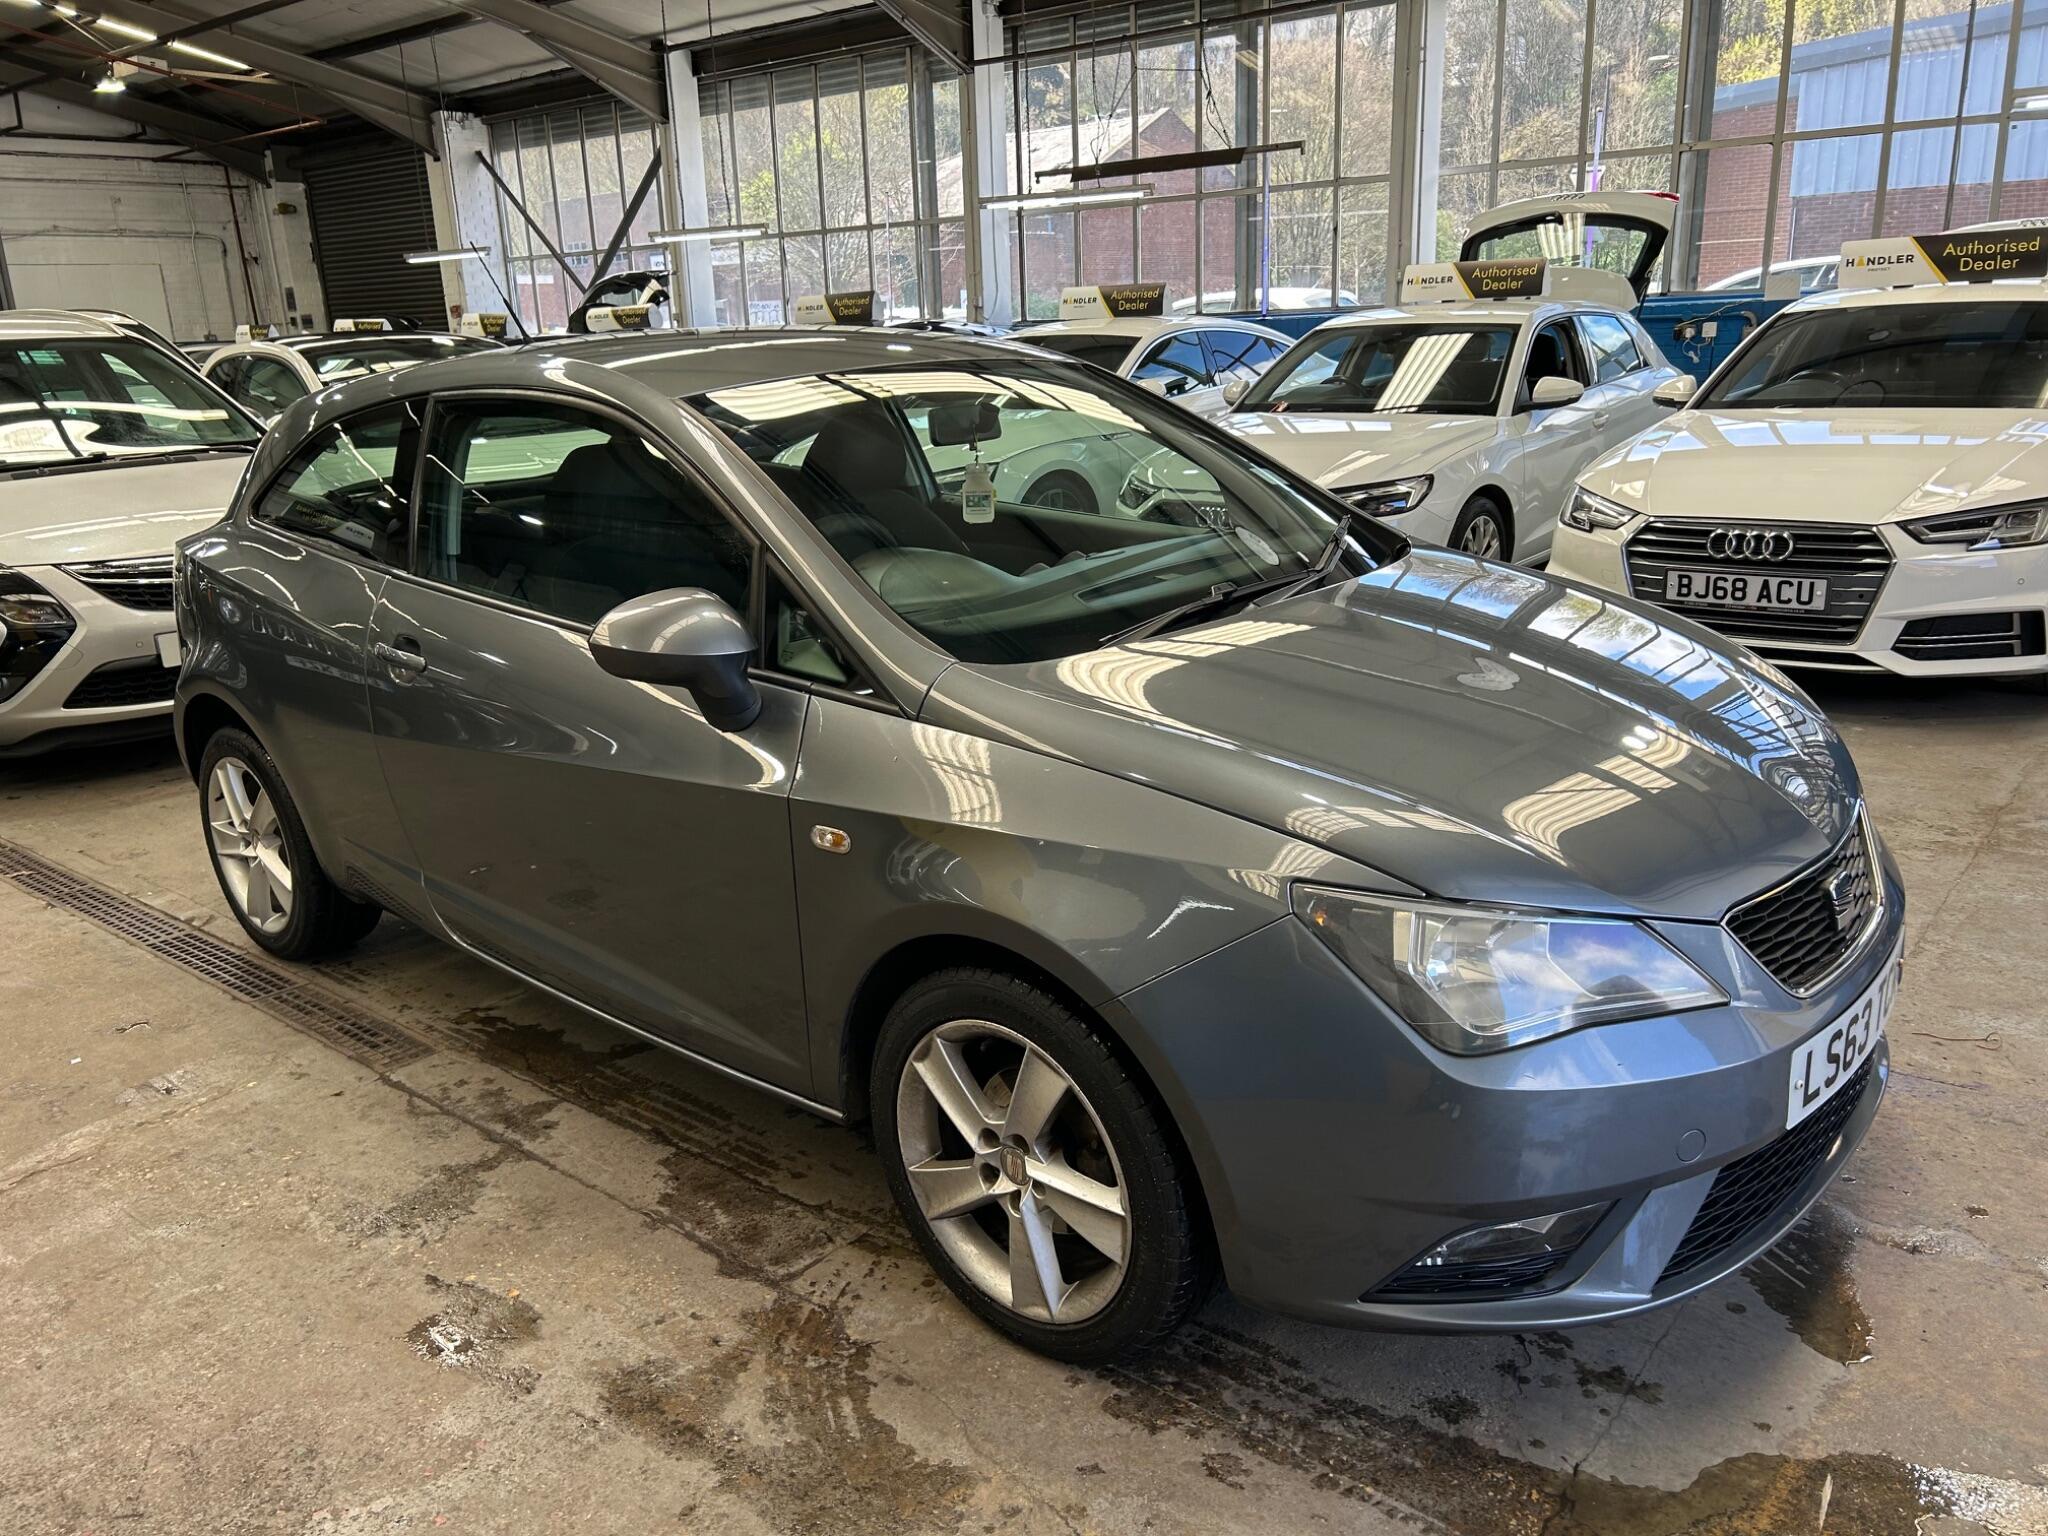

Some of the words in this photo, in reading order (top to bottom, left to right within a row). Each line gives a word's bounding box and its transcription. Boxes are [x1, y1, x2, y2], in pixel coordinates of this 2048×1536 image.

[1943, 236, 2040, 256] Authorised
[1959, 255, 2020, 272] Dealer
[1471, 264, 1538, 278] Authorised
[1482, 278, 1523, 291] Dealer
[1111, 287, 1160, 300] Authorised
[833, 295, 870, 307] Authorised
[1118, 300, 1149, 311] Dealer
[839, 305, 862, 316] Dealer
[1676, 574, 1748, 601] BJ68
[1756, 579, 1815, 606] ACU
[1802, 998, 1873, 1108] LS63
